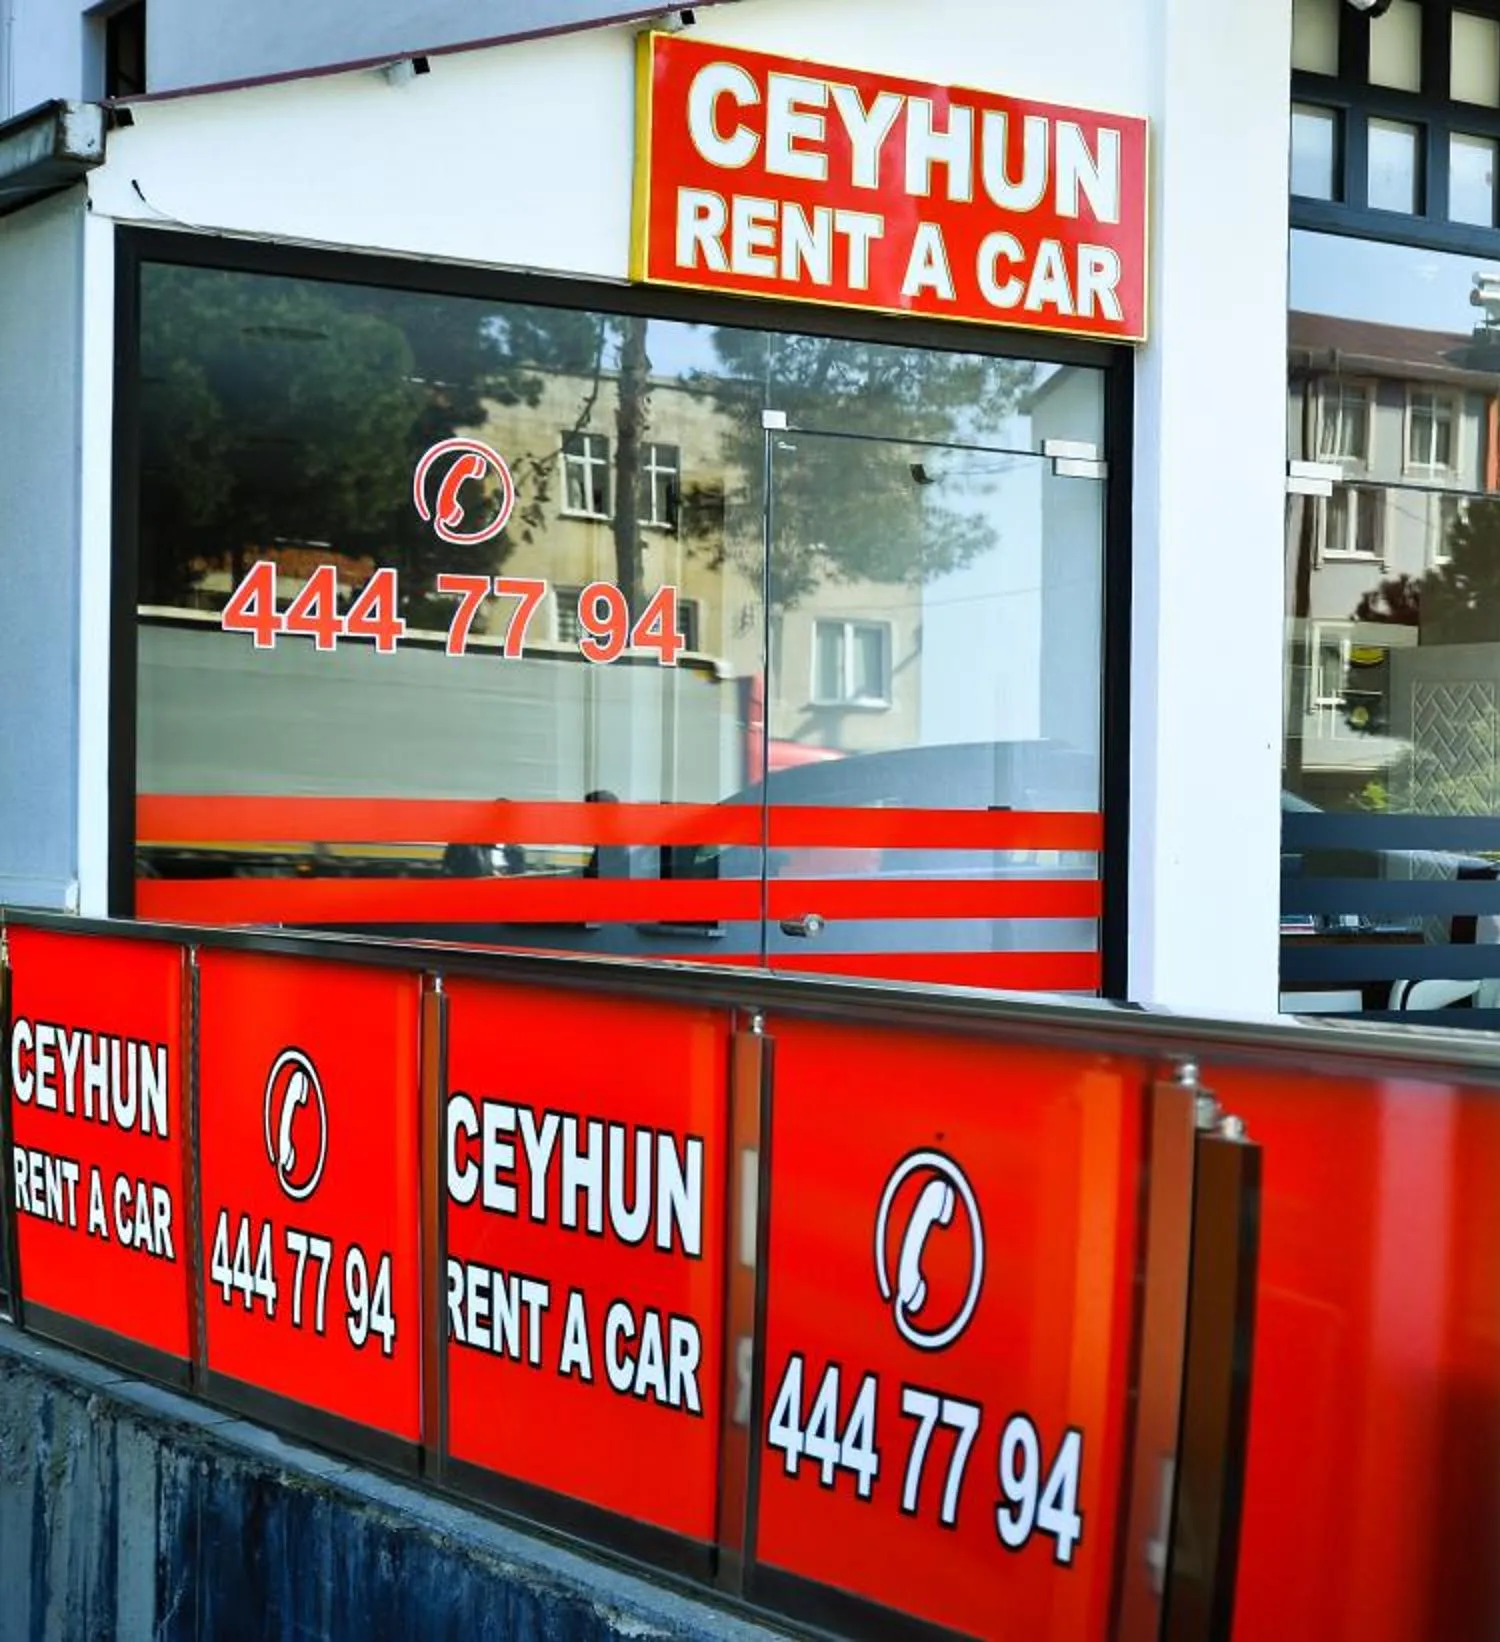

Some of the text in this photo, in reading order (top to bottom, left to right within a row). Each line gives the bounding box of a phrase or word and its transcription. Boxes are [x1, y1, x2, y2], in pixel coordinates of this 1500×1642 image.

[687, 61, 1122, 225] CEYHUN
[675, 186, 1125, 322] RENT A CAR
[222, 561, 685, 665] 444 77 94
[11, 1018, 168, 1138] CEYHUN
[13, 1145, 174, 1259] RENT A CAR
[447, 1094, 702, 1256] CEYHUN
[211, 1210, 395, 1354] 444 77 94
[447, 1258, 700, 1412] RENT A CAR
[768, 1356, 1082, 1562] 444 77 94
